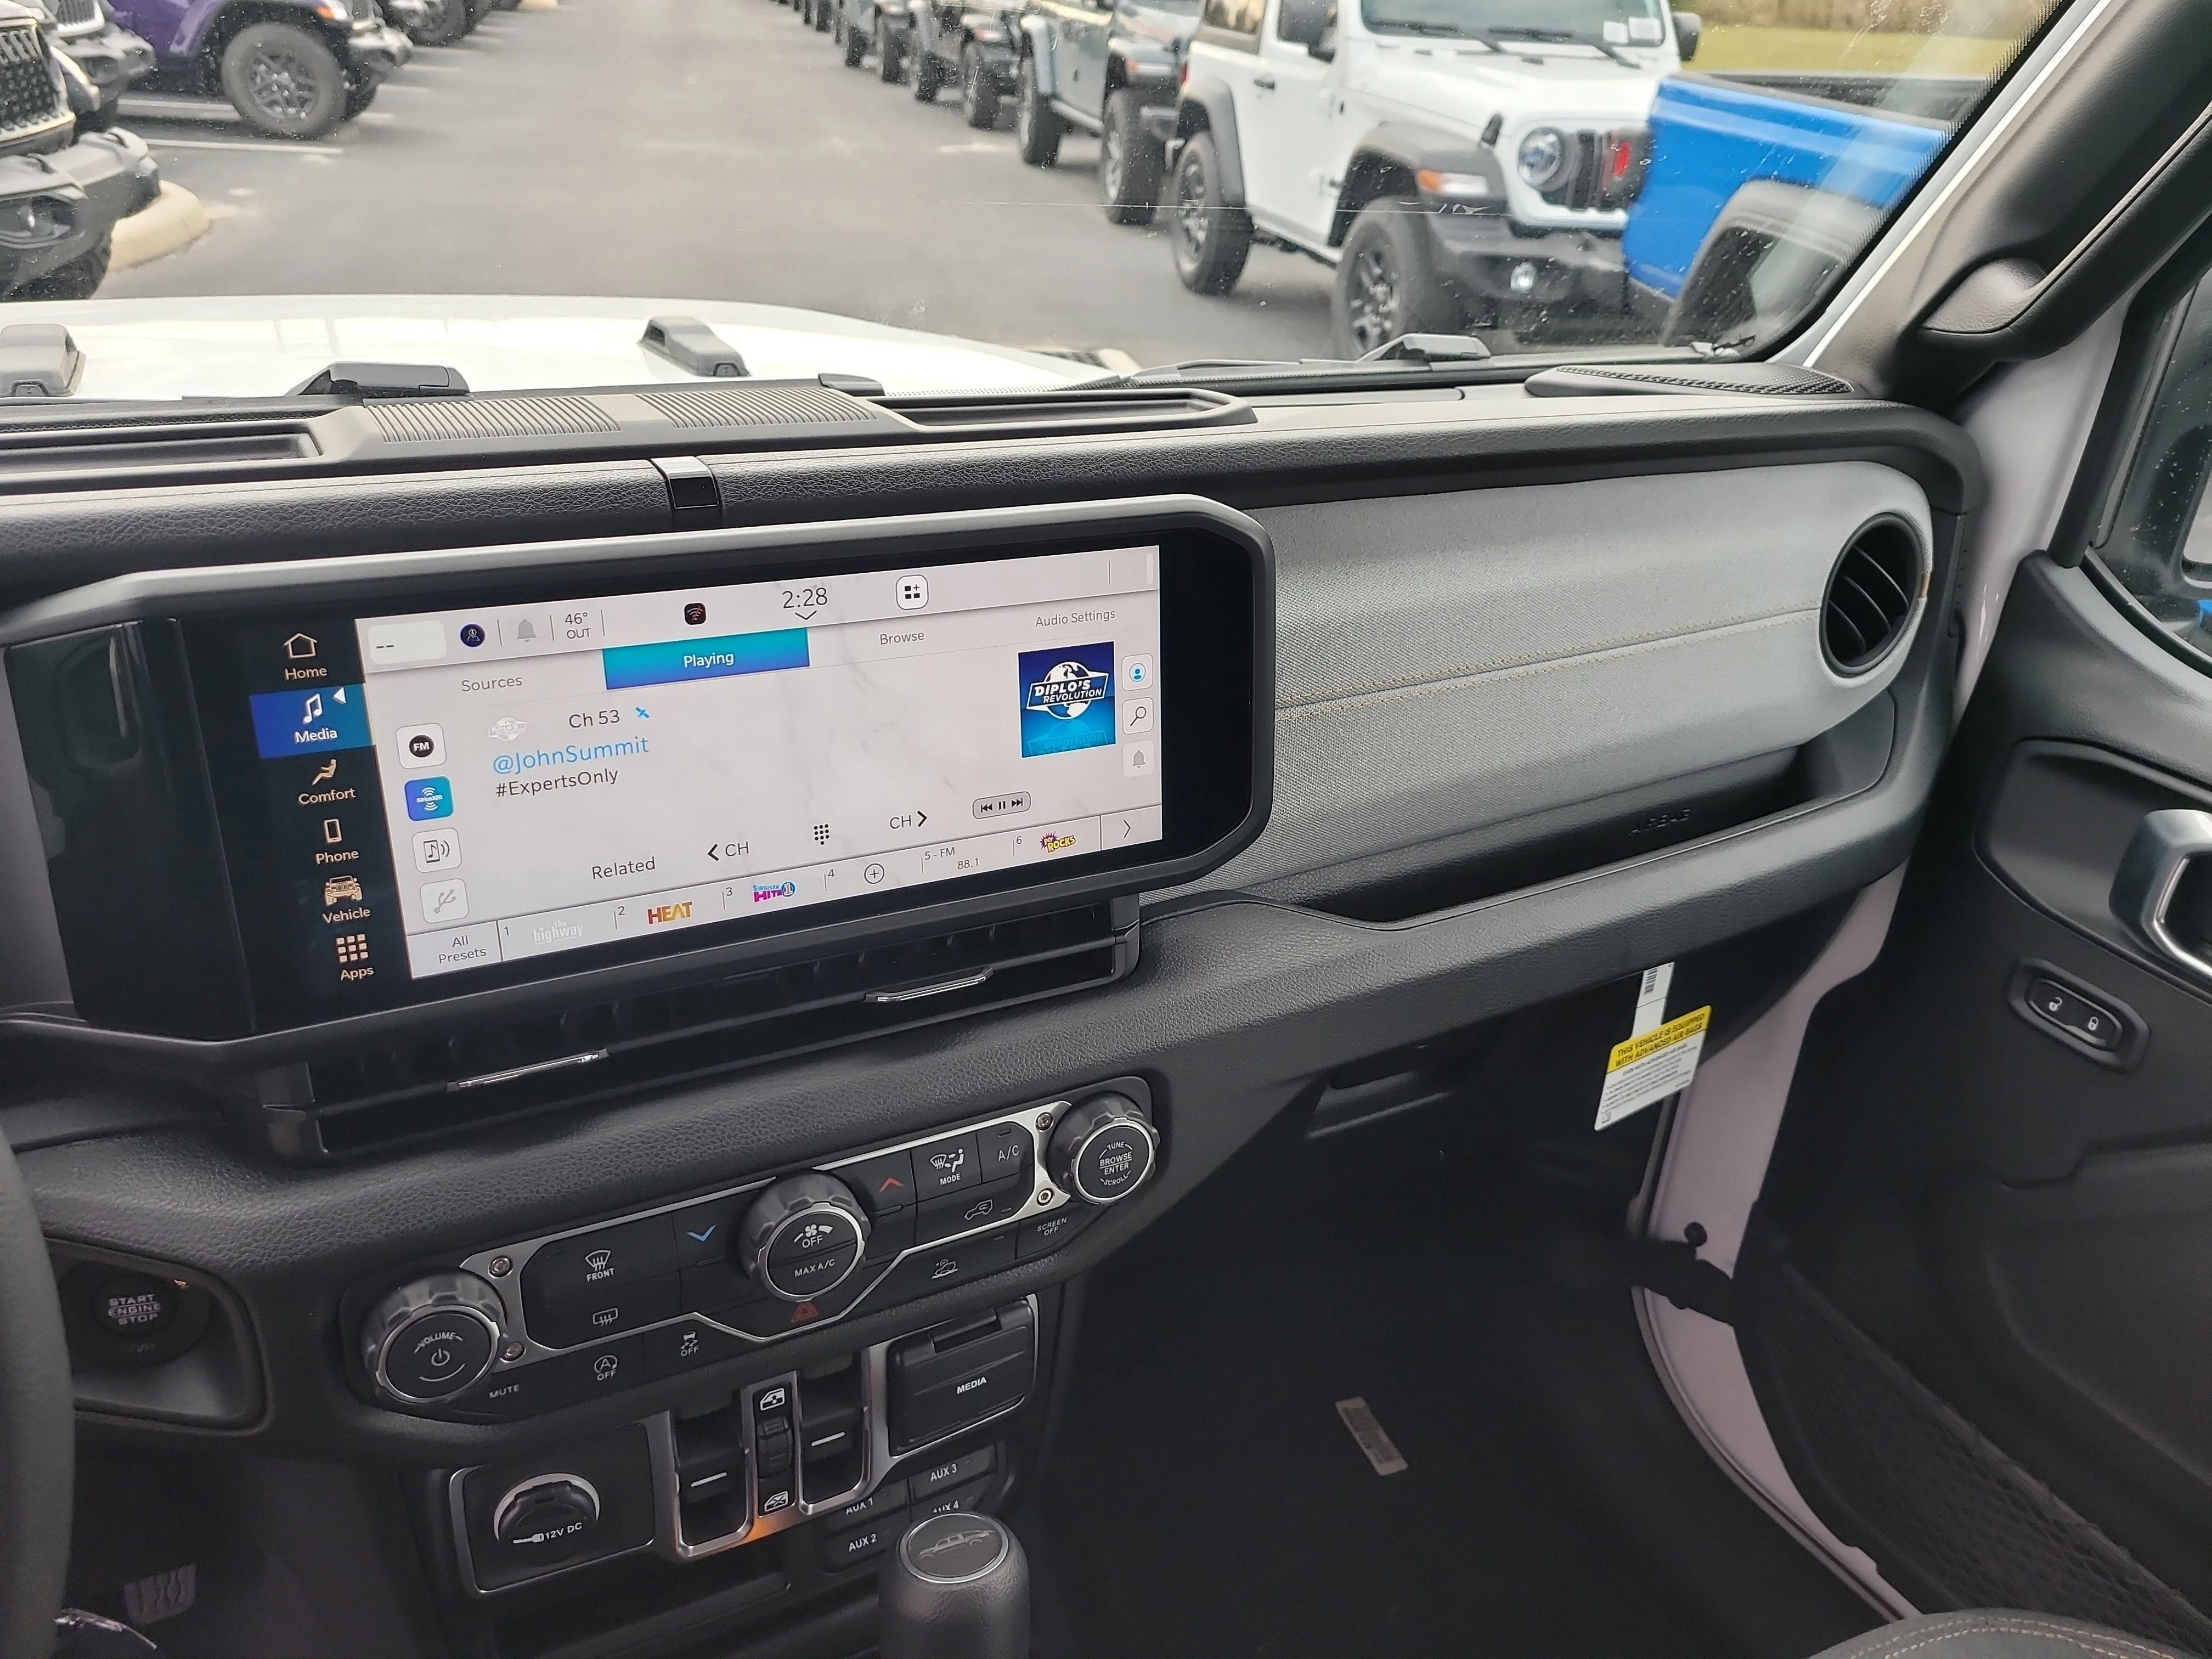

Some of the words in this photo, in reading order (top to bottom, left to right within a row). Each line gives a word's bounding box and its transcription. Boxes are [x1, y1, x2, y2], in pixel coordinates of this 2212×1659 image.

[782, 587, 828, 609] 2:28
[564, 612, 589, 625] 46°
[1035, 613, 1069, 628] Audio
[1071, 608, 1116, 625] Settings
[566, 627, 591, 639] OUT
[879, 630, 925, 645] Browse
[684, 651, 735, 669] Playing
[284, 664, 328, 680] Home
[460, 675, 523, 692] Sources
[1034, 679, 1091, 697] DIPLO'S
[1043, 688, 1103, 704] REVOLUTION
[568, 712, 594, 728] Ch
[598, 709, 620, 725] 53
[295, 726, 338, 743] Media
[414, 741, 430, 752] FM
[493, 736, 650, 775] @JohnSummit
[496, 768, 619, 798] #ExpertsOnly
[297, 787, 357, 805] Comfort
[889, 815, 912, 830] CH
[1016, 836, 1023, 845] 6
[1047, 835, 1076, 852] ROCKS
[725, 841, 750, 857] CH
[924, 851, 931, 860] 5
[940, 847, 956, 857] FM
[315, 849, 360, 865] Phone
[957, 857, 979, 870] 88.1
[592, 856, 656, 880] Related
[827, 869, 836, 878] 4
[726, 887, 733, 896] 3
[783, 882, 793, 896] 1
[323, 907, 371, 924] Vehicle
[618, 906, 626, 916] 2
[647, 901, 693, 925] HEAT
[504, 926, 510, 936] 1
[533, 924, 583, 943] highway
[452, 935, 470, 947] All
[438, 947, 487, 964] Presets
[340, 966, 375, 981] Apps
[1617, 1044, 1634, 1058] THIS
[997, 1144, 1020, 1161] A/C
[1107, 1141, 1126, 1151] TUNE
[1099, 1152, 1133, 1166] BROWSE
[1104, 1163, 1130, 1175] ENTER
[940, 1173, 961, 1186] MODE
[1103, 1173, 1129, 1186] SCROLL
[1037, 1216, 1068, 1232] SCREEN
[1043, 1226, 1059, 1236] OFF
[802, 1234, 823, 1248] OFF
[586, 1268, 615, 1282] FRONT
[794, 1264, 817, 1278] MAX
[816, 1258, 836, 1273] A/C
[108, 1294, 155, 1307] START
[108, 1302, 162, 1317] ENGINE
[118, 1313, 159, 1325] STOP
[419, 1331, 456, 1347] VOLUME
[680, 1344, 699, 1357] OFF
[597, 1368, 617, 1381] OFF
[489, 1383, 520, 1399] MUTE
[956, 1376, 987, 1394] MEDIA
[930, 1466, 951, 1482] AUX
[951, 1464, 957, 1473] 3
[845, 1502, 866, 1515] AUX
[868, 1497, 873, 1505] 1
[953, 1499, 959, 1508] 4
[545, 1527, 565, 1541] 12V
[567, 1522, 583, 1535] DC
[848, 1536, 870, 1552] AUX
[870, 1533, 877, 1543] 2
